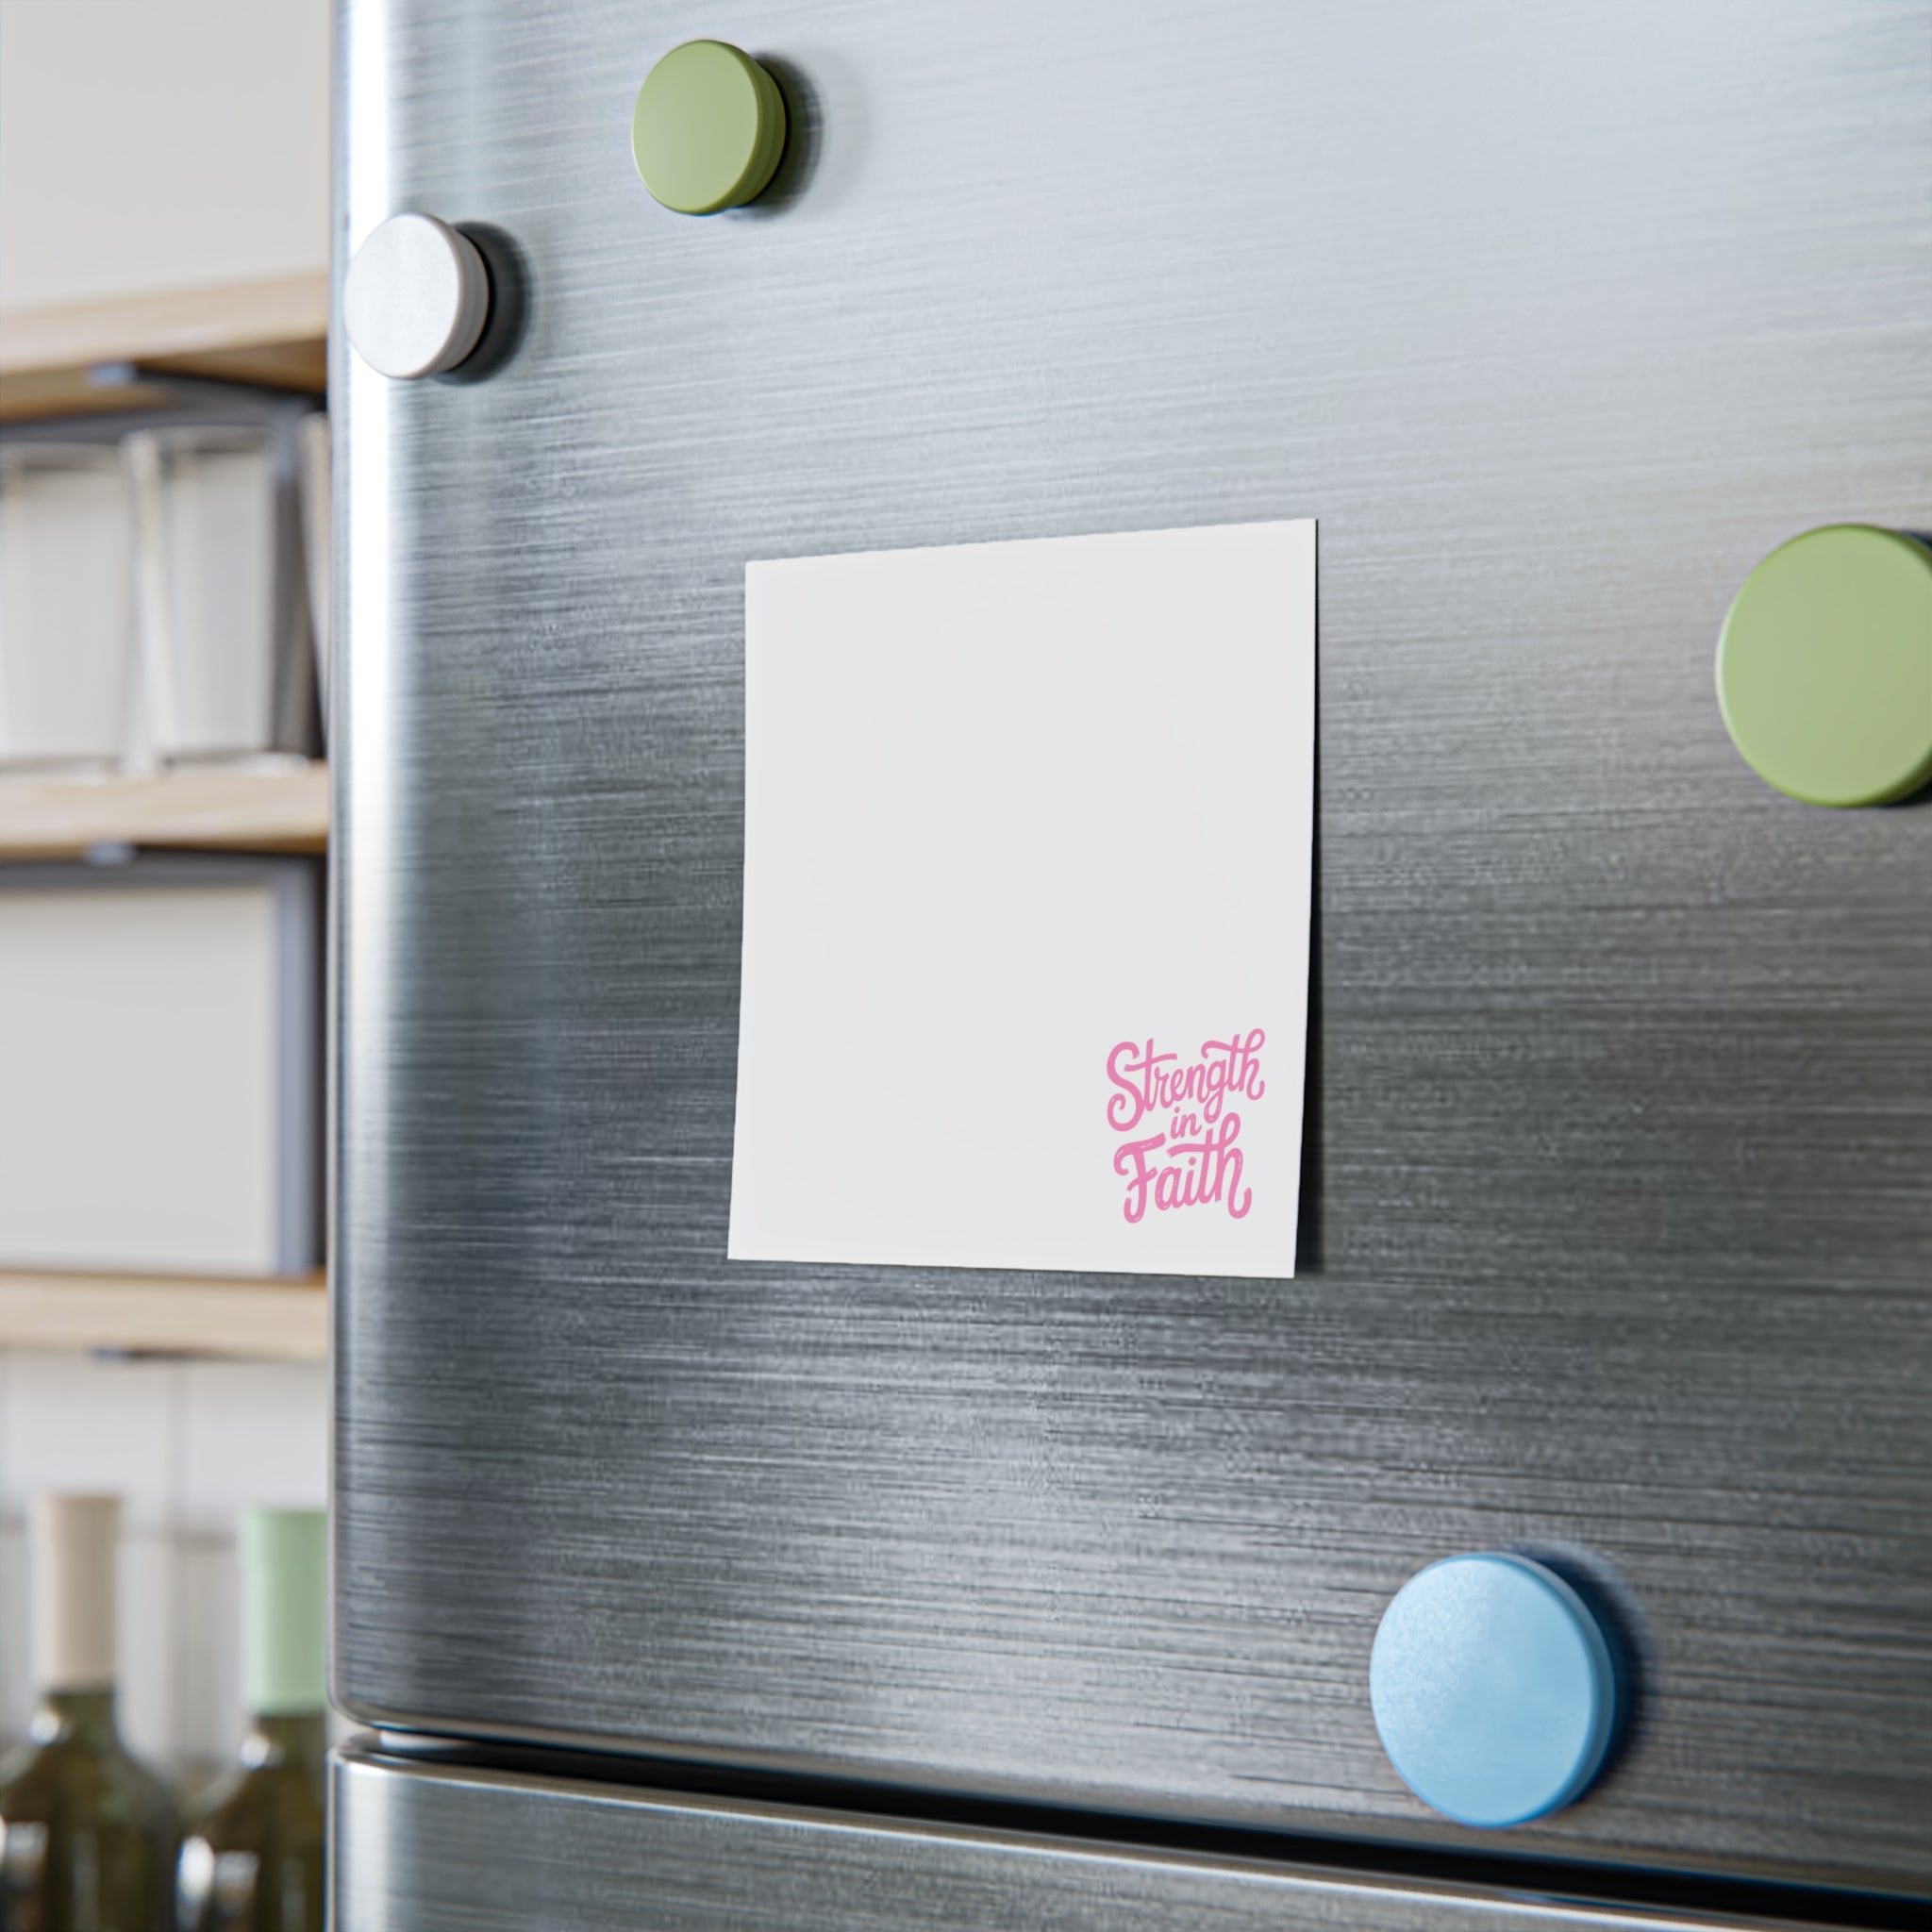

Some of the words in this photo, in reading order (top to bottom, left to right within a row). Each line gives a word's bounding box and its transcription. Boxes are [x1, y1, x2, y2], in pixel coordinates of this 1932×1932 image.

[1107, 1027, 1266, 1132] Strength
[1170, 1106, 1203, 1140] in
[1113, 1111, 1253, 1224] Faith
